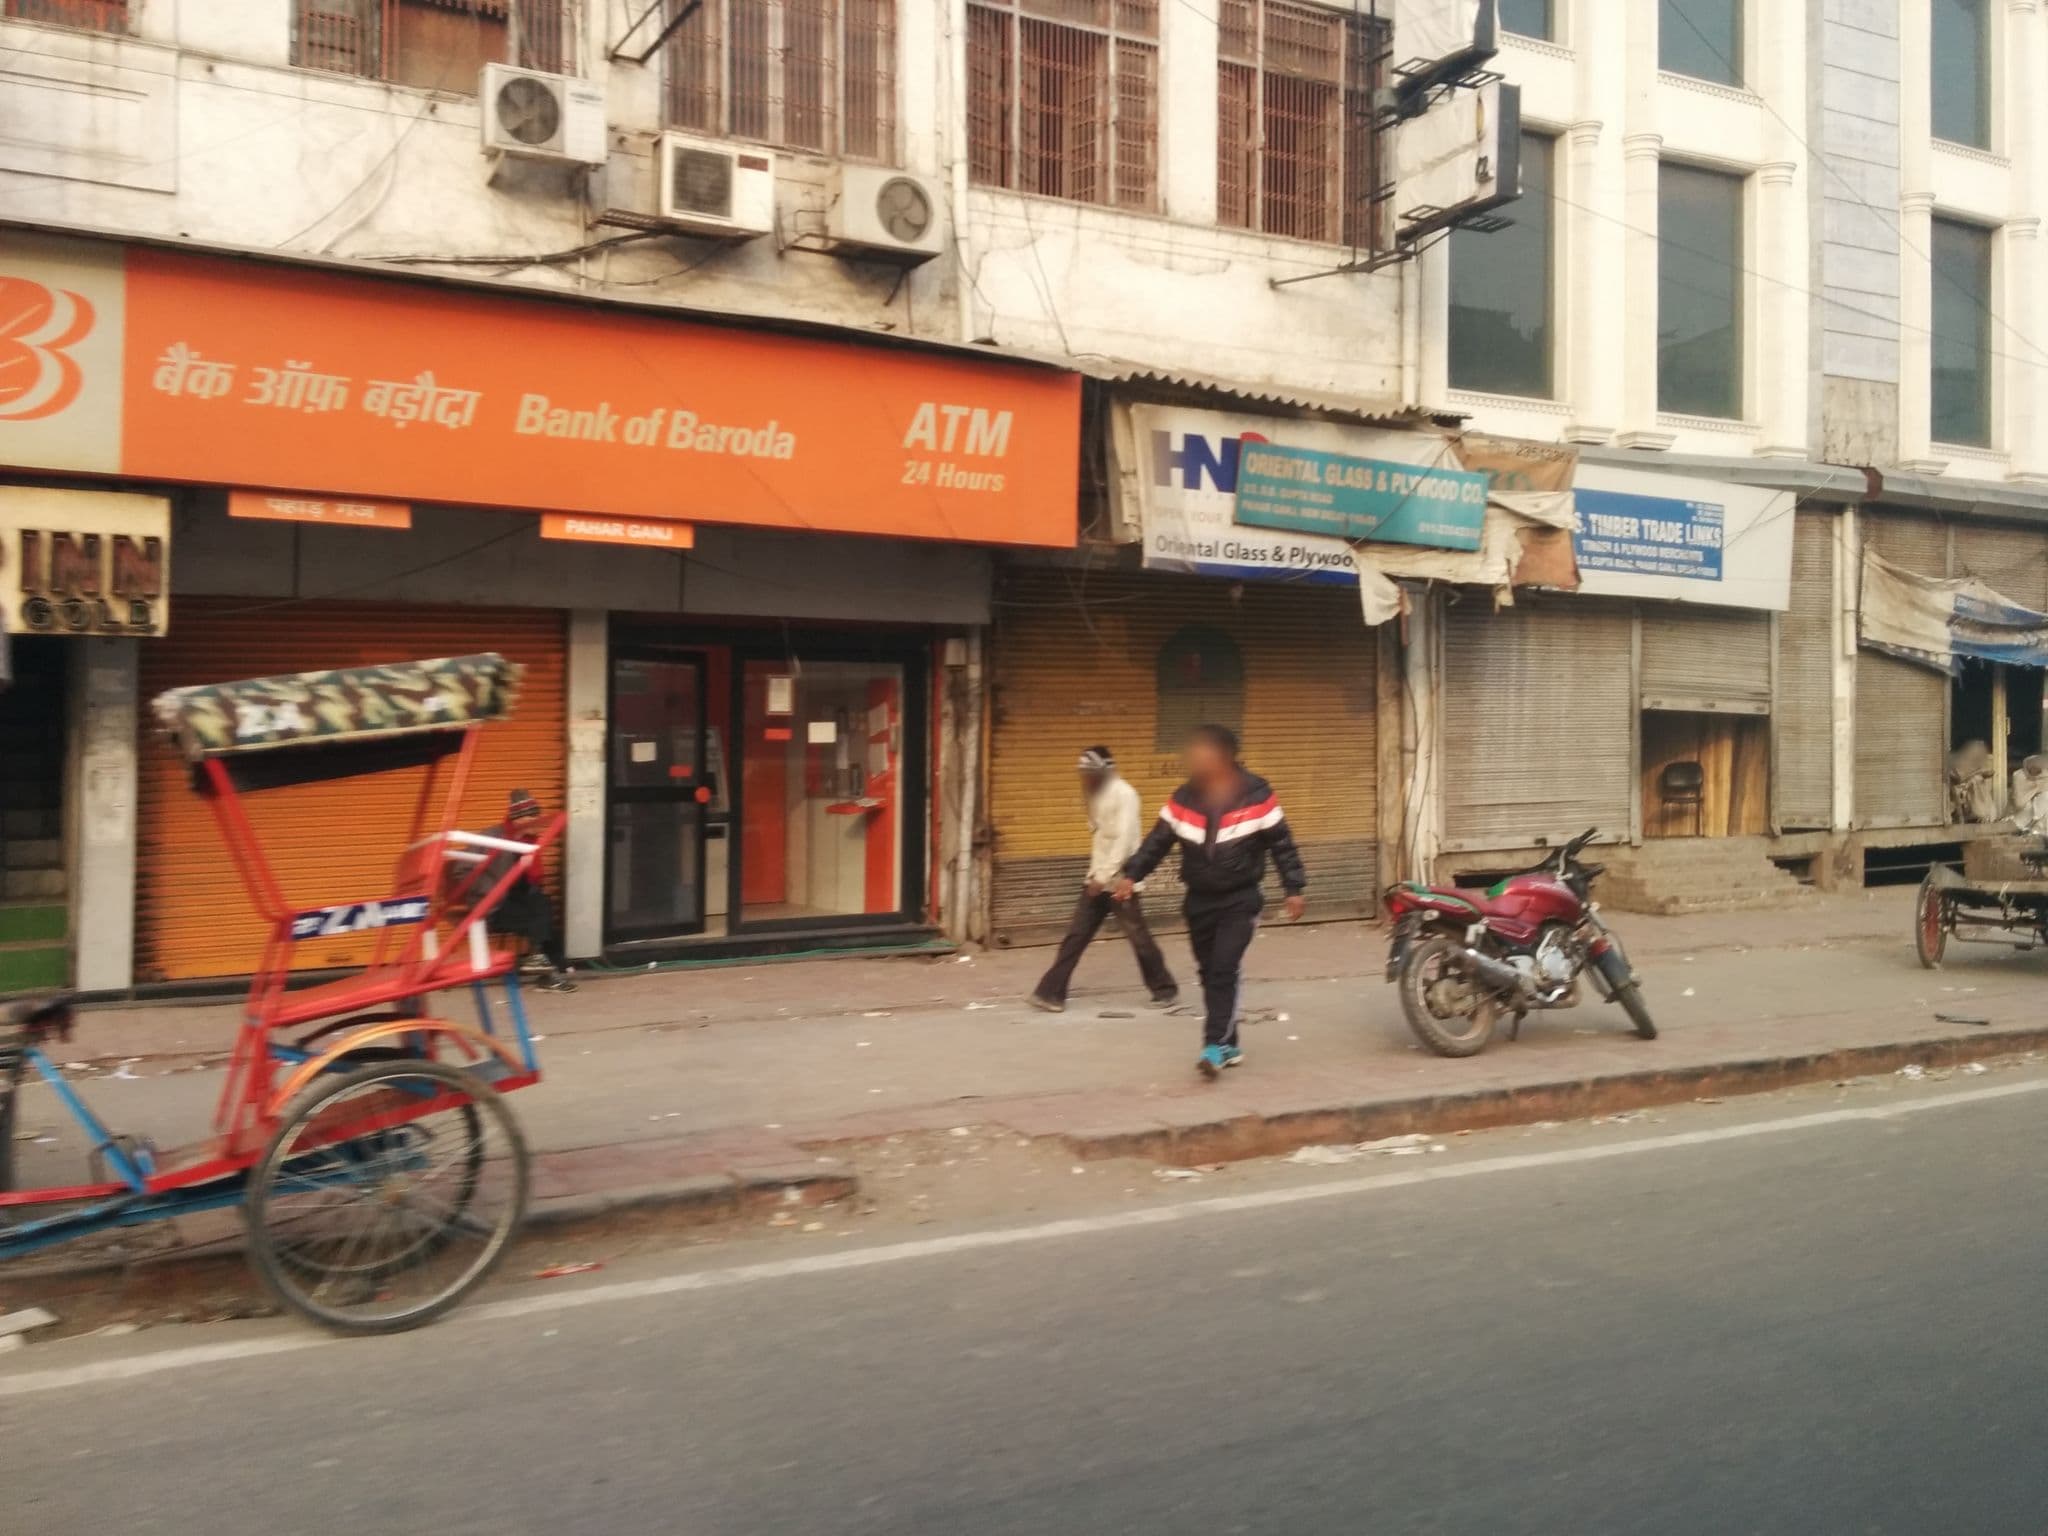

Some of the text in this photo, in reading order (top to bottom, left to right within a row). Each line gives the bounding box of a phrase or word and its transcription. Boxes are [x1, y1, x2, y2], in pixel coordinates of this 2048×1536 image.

[152, 341, 238, 399] बैंक
[362, 370, 484, 429] बड़ौदा
[514, 392, 796, 460] Bank of Baroda
[902, 402, 1014, 458] ATM
[901, 460, 1005, 492] 24 Hours
[1151, 430, 1269, 493] HN
[1245, 451, 1321, 484] ORIENTAL
[1325, 464, 1373, 490] GLASS
[1376, 471, 1388, 492] &
[1391, 472, 1459, 501] PLYWOOD
[1156, 535, 1354, 568] Oriental Glass & Plywoo
[1589, 513, 1639, 539] TIMBER
[1641, 519, 1683, 544] TRADE
[1685, 523, 1722, 548] LINKS
[21, 528, 161, 600] INN
[22, 596, 159, 632] GOLD
